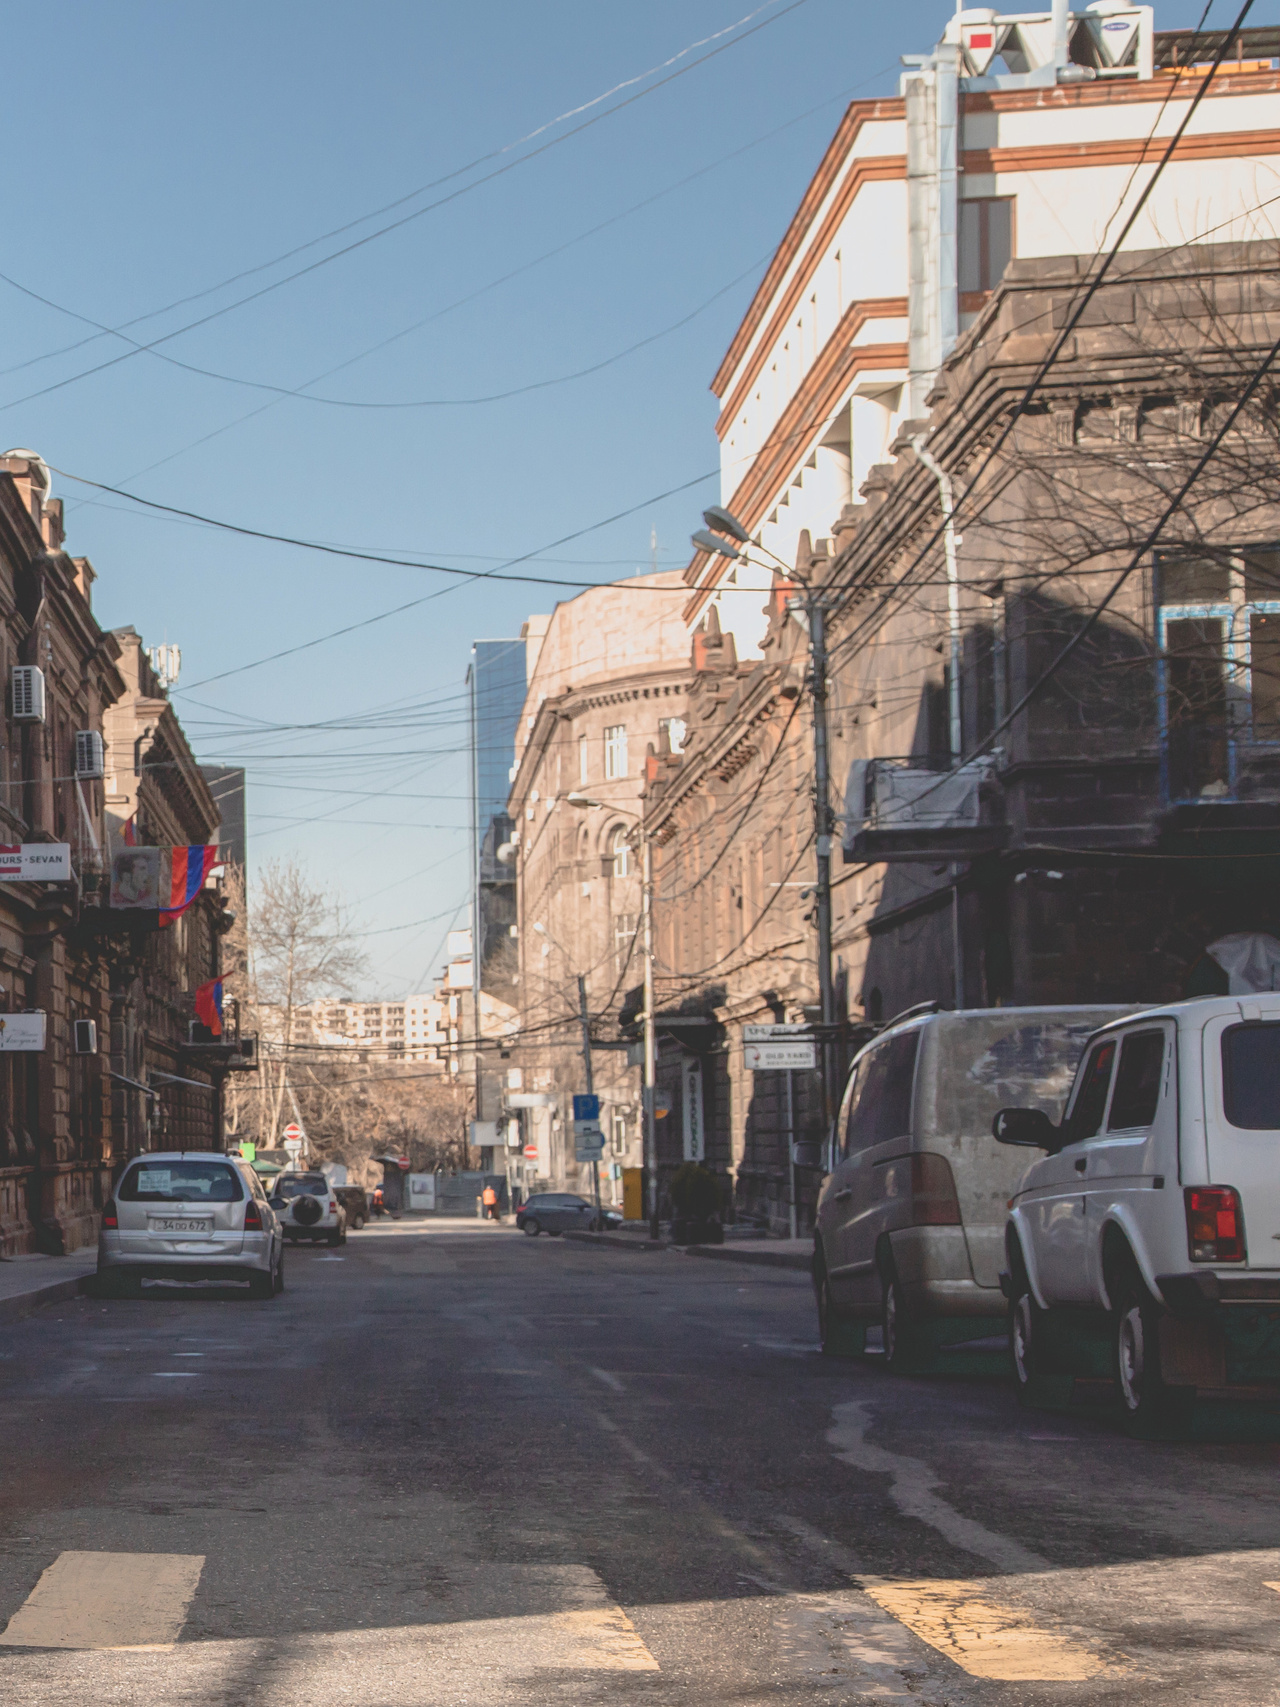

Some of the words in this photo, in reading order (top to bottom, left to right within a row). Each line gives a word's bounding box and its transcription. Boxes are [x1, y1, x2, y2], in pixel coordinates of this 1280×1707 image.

[29, 855, 63, 863] SEVAN
[579, 1097, 593, 1118] P
[189, 1220, 206, 1230] 672
